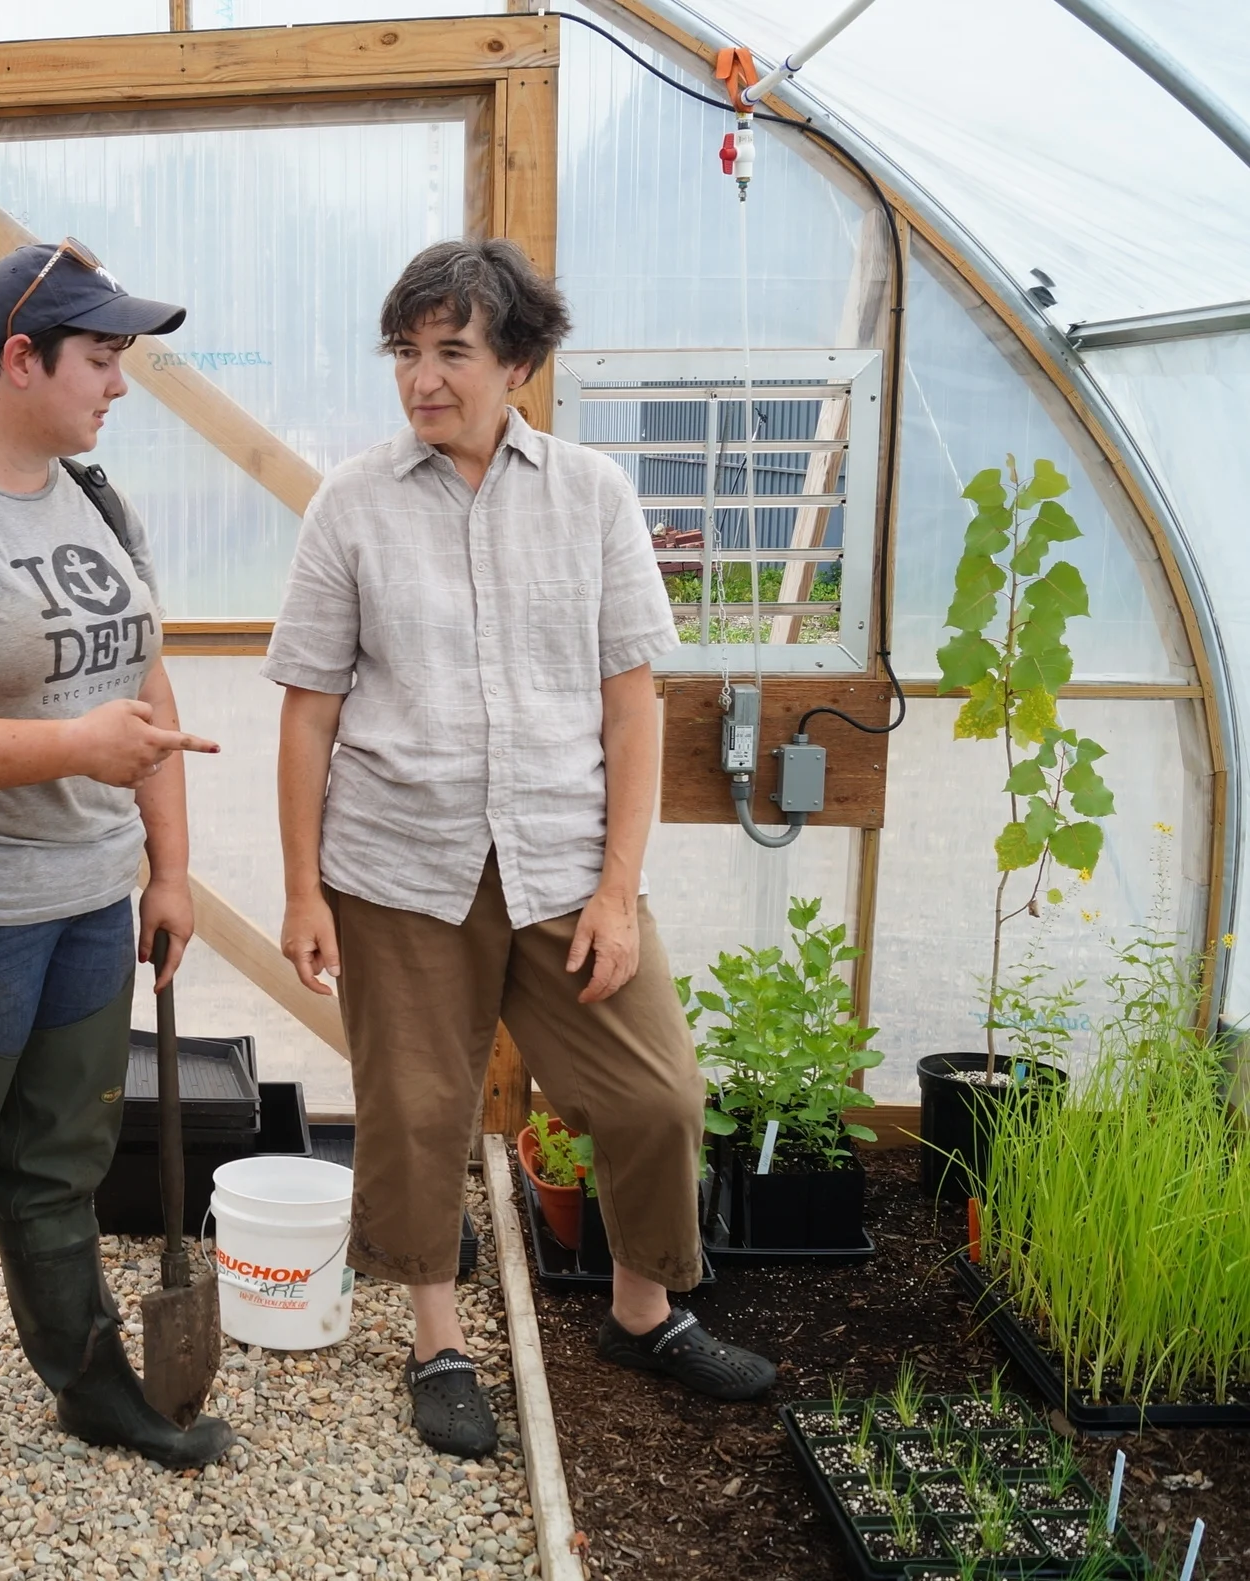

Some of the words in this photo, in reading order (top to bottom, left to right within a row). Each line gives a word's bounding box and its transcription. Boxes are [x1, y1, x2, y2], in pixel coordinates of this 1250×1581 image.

[10, 556, 72, 619] I
[44, 612, 154, 683] DET
[42, 689, 81, 705] ERYC
[216, 1249, 310, 1283] BUCHON
